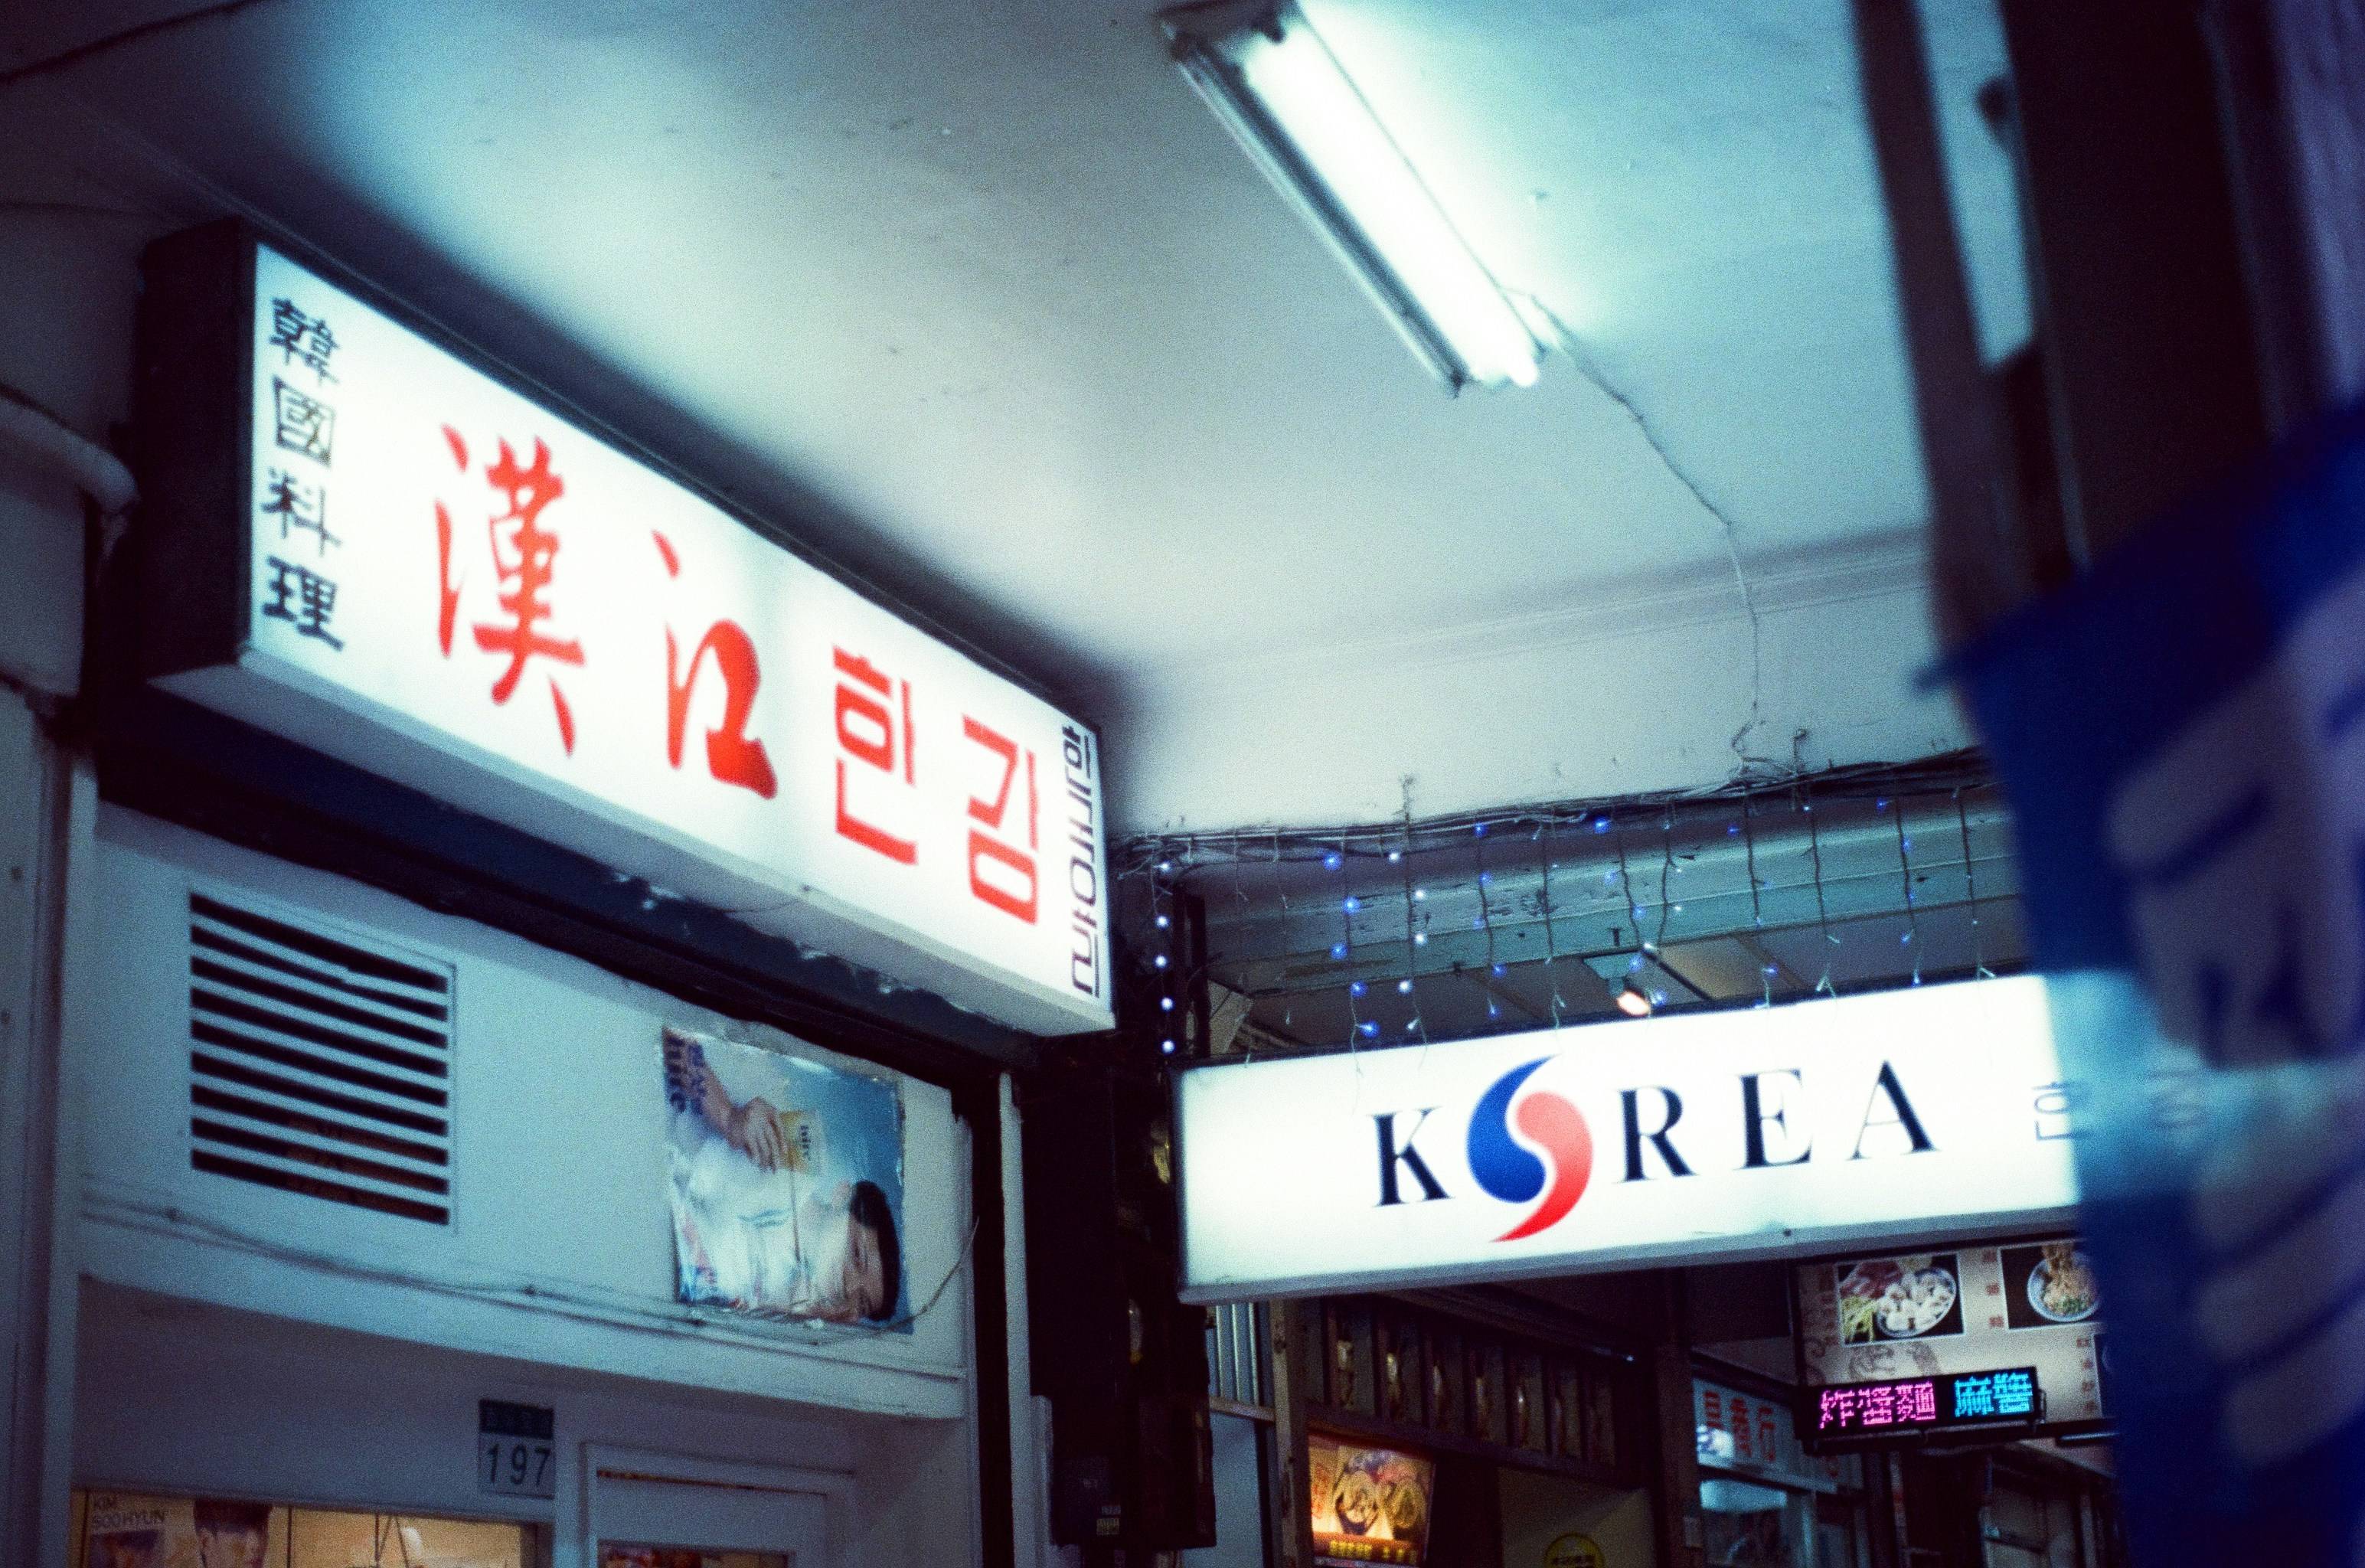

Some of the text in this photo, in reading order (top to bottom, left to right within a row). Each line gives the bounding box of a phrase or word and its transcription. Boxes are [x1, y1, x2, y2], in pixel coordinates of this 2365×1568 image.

[261, 297, 345, 652] 韓國料理
[435, 425, 778, 800] 漢江
[488, 1442, 553, 1487] 197
